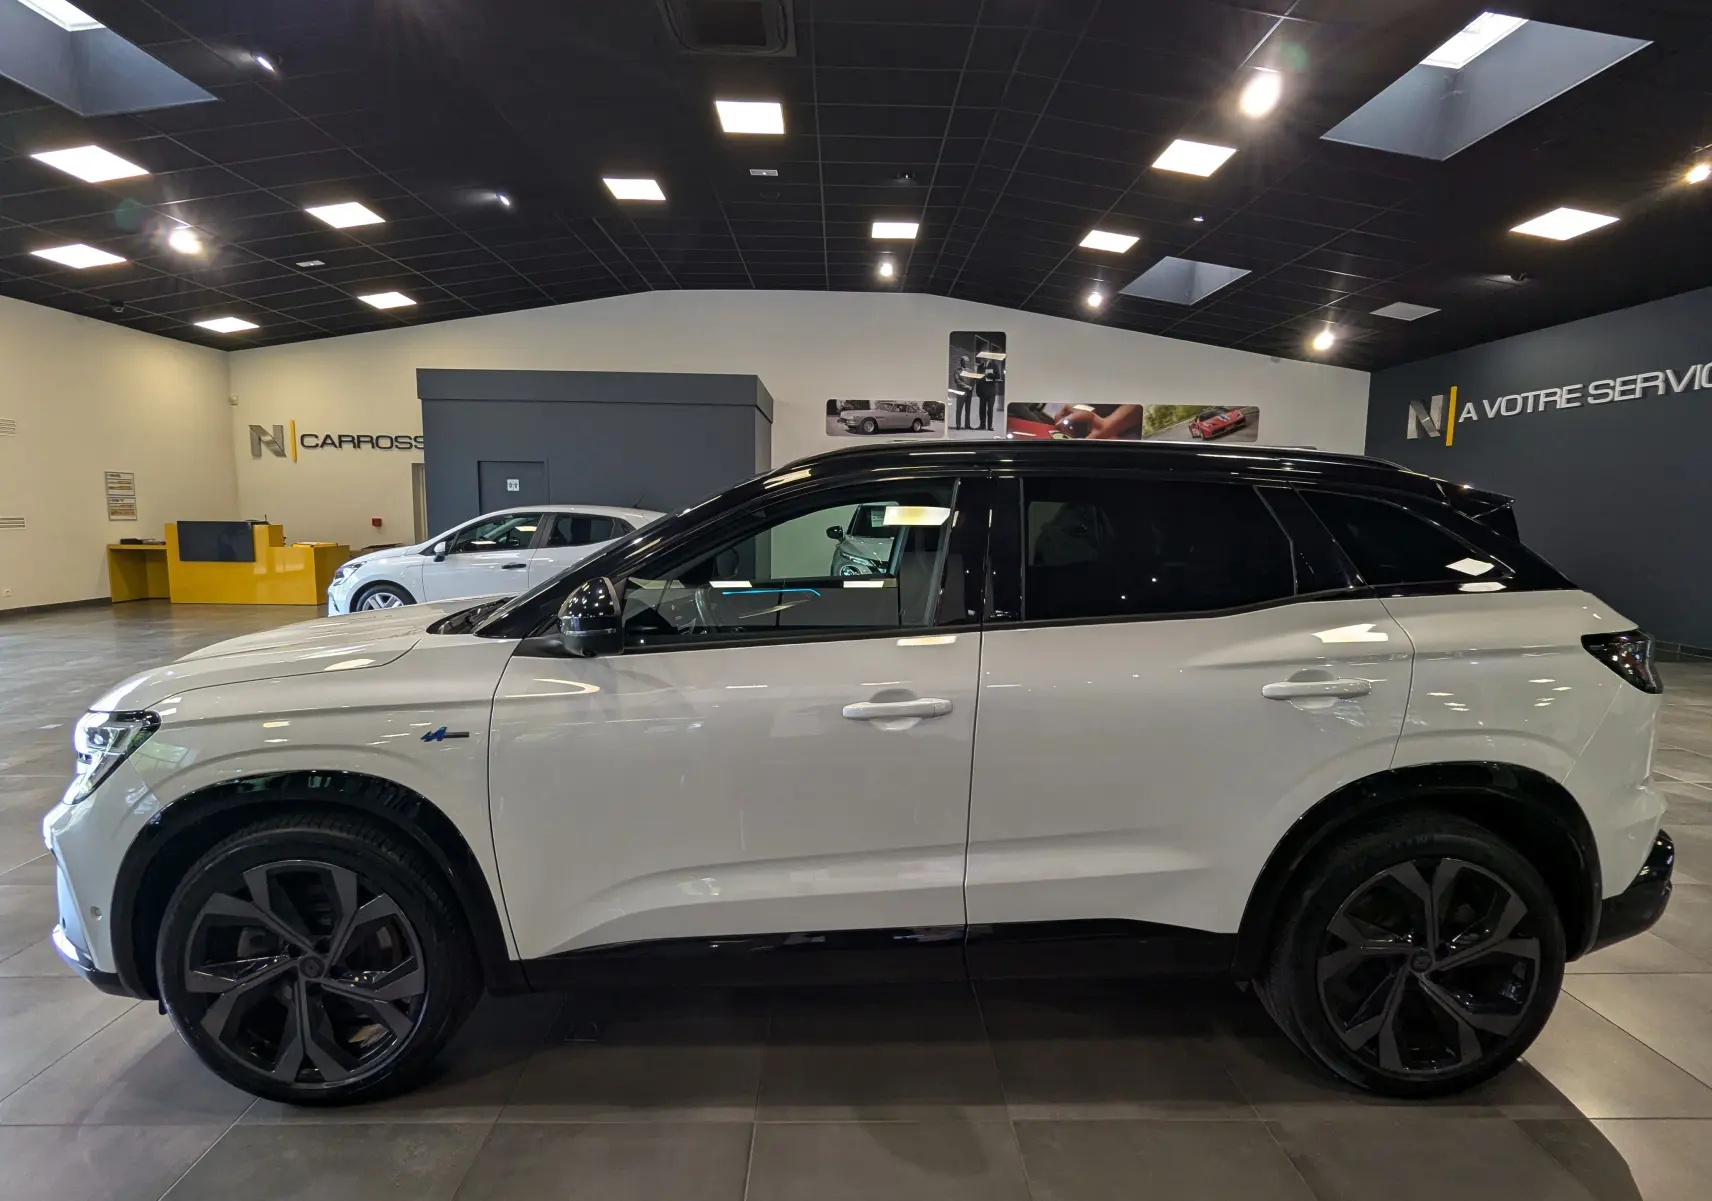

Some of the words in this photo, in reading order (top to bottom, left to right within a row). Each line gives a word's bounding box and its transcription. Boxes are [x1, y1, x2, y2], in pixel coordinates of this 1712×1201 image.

[1406, 394, 1445, 439] N
[1483, 384, 1584, 419] VOTRE
[249, 424, 287, 458] N
